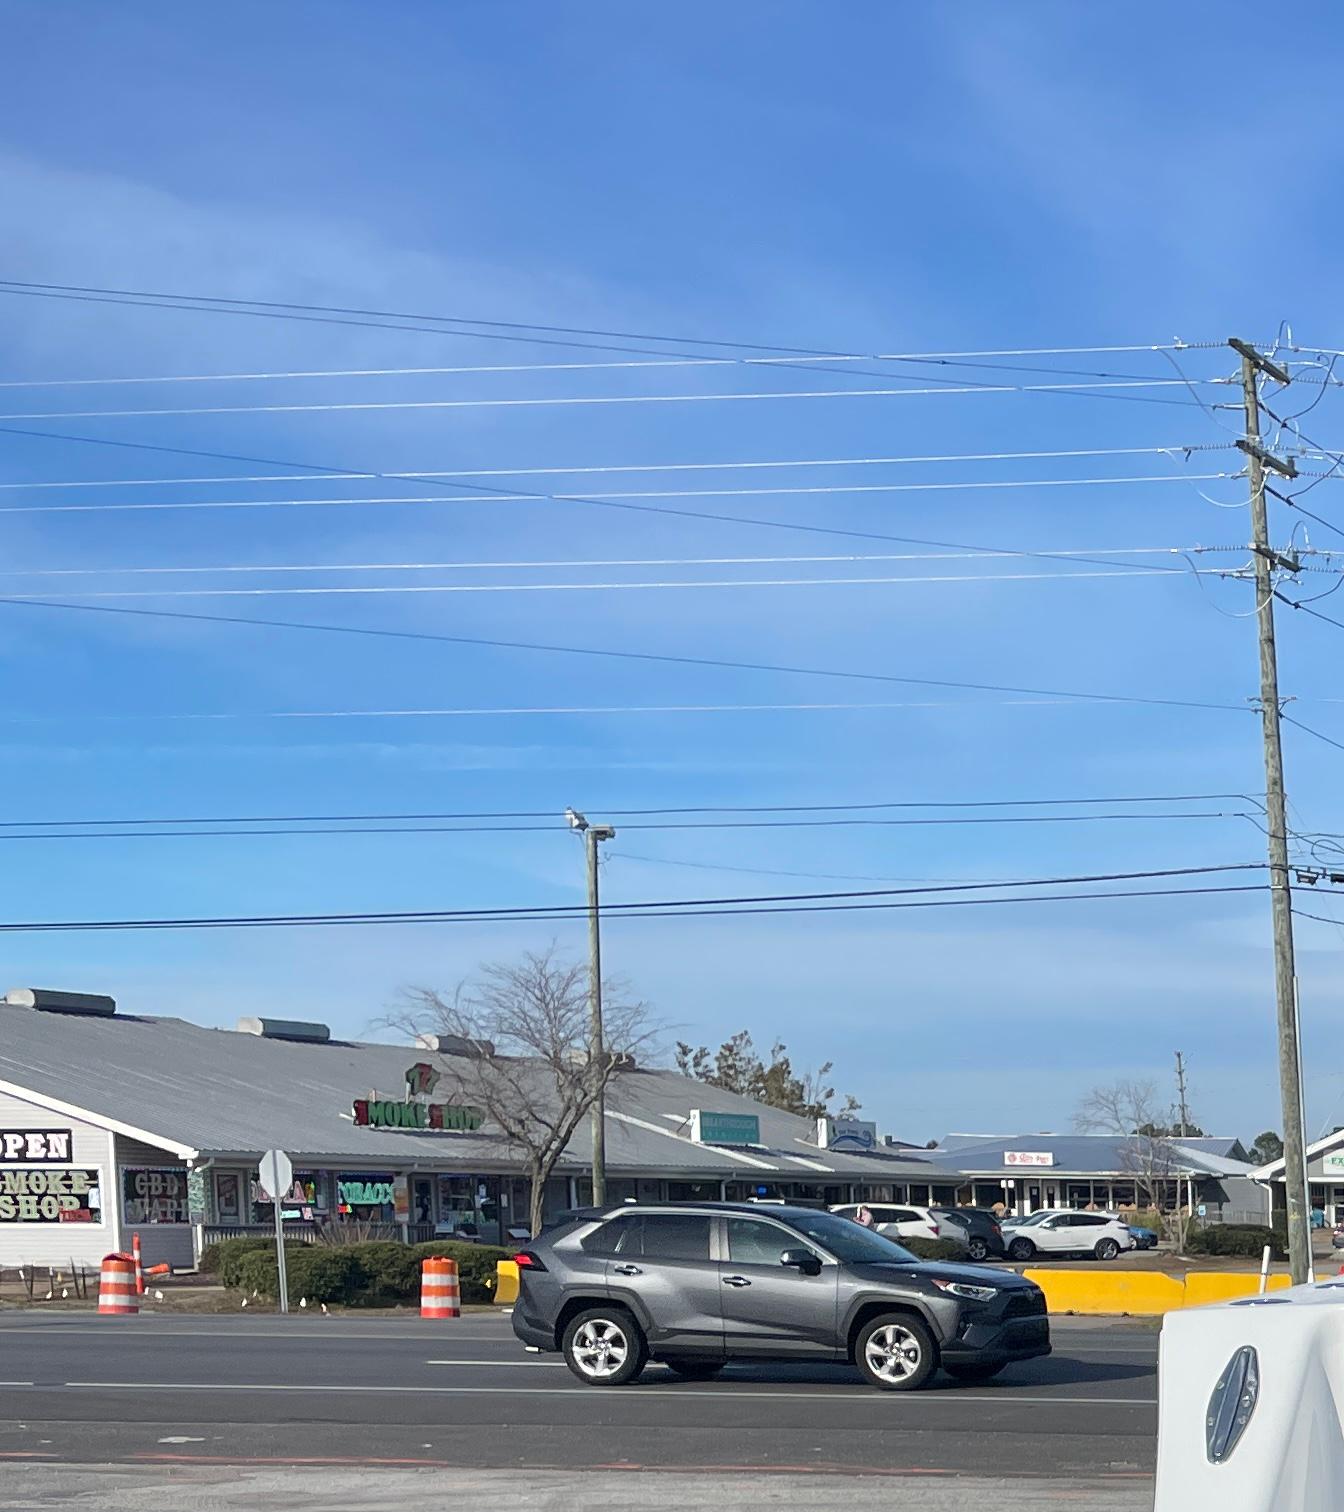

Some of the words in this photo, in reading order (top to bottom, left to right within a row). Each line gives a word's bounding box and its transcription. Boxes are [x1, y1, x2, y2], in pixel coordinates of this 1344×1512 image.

[352, 1100, 427, 1128] SMOKE
[0, 1133, 69, 1158] PEN
[0, 1171, 89, 1194] MOKE
